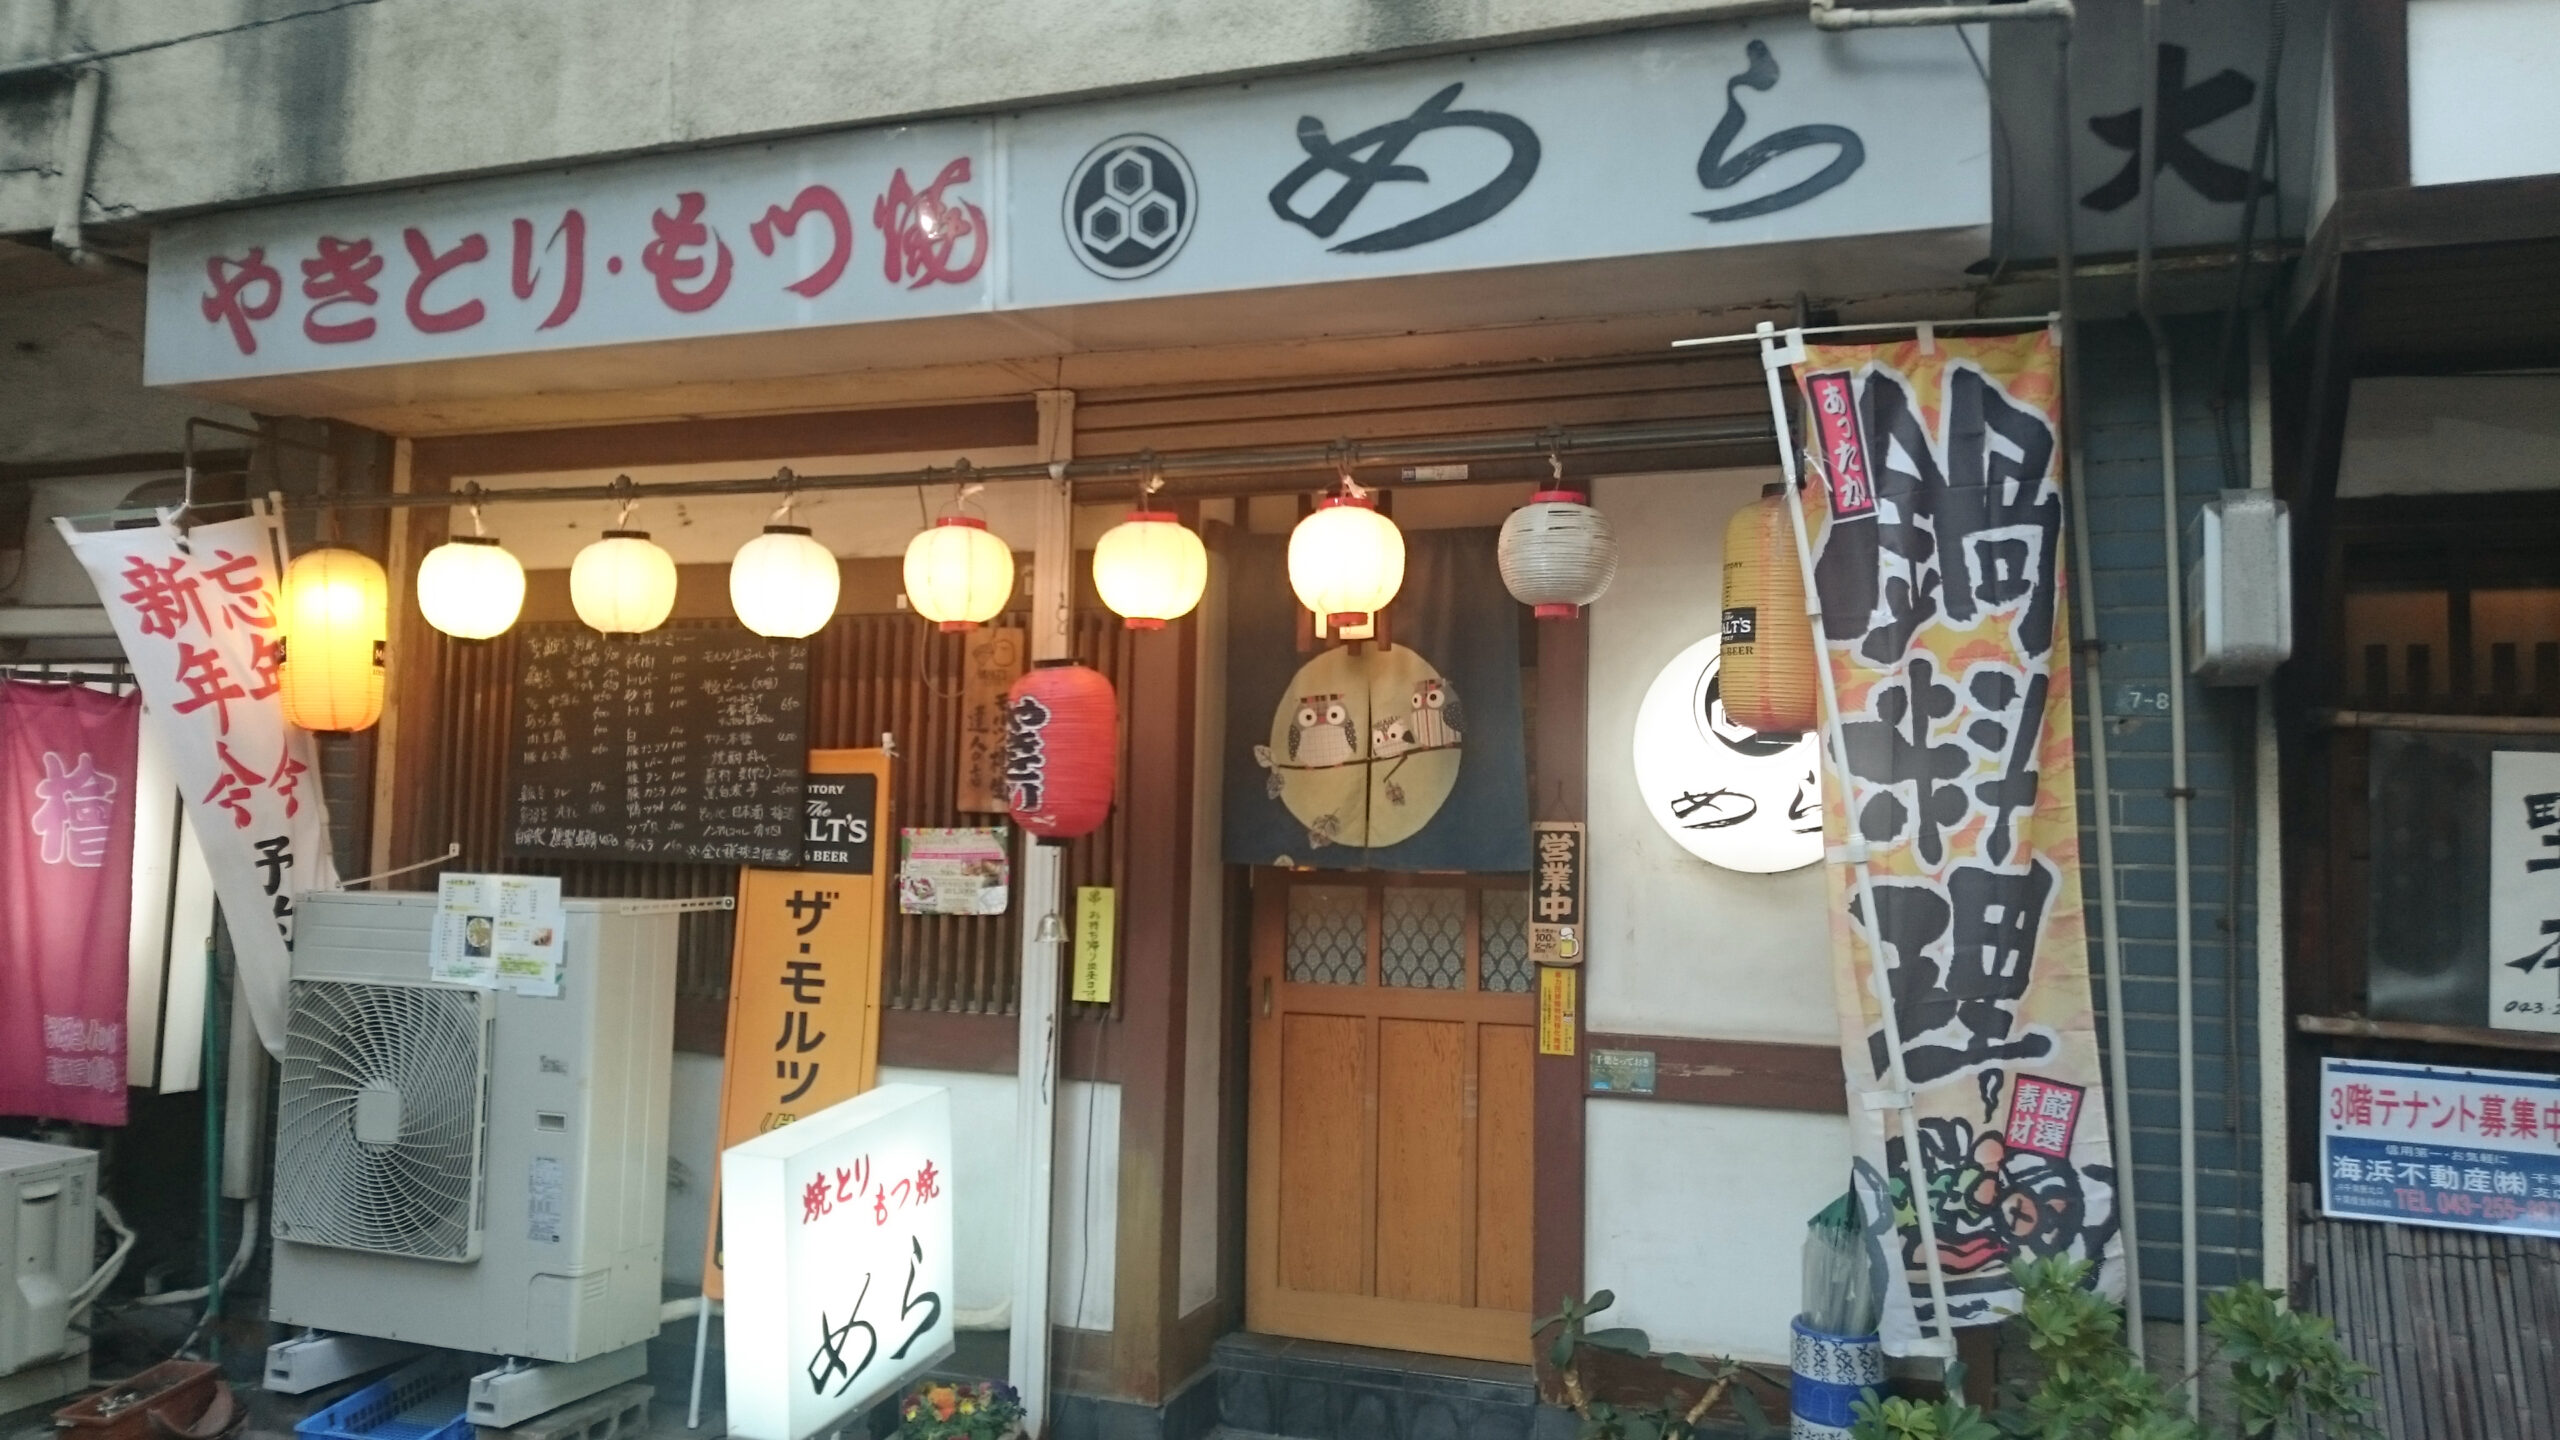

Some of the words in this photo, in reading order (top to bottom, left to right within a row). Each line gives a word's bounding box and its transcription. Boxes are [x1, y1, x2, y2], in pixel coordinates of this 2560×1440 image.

[1268, 38, 1866, 254] めら
[1821, 382, 1868, 508] あったか
[2129, 691, 2170, 710] 7-8
[805, 799, 831, 817] The
[805, 813, 868, 844] LT'S
[813, 851, 849, 863] BEER
[1539, 832, 1574, 922] 営業中
[775, 889, 839, 1104] ザ・モルツ
[2009, 1083, 2041, 1145] 素材
[2330, 1083, 2560, 1142] 3階テナント募集中
[803, 1153, 870, 1225] 焼とり
[873, 1158, 940, 1227] もつ焼
[2394, 1187, 2433, 1213] TEL
[807, 1234, 942, 1399] めら
